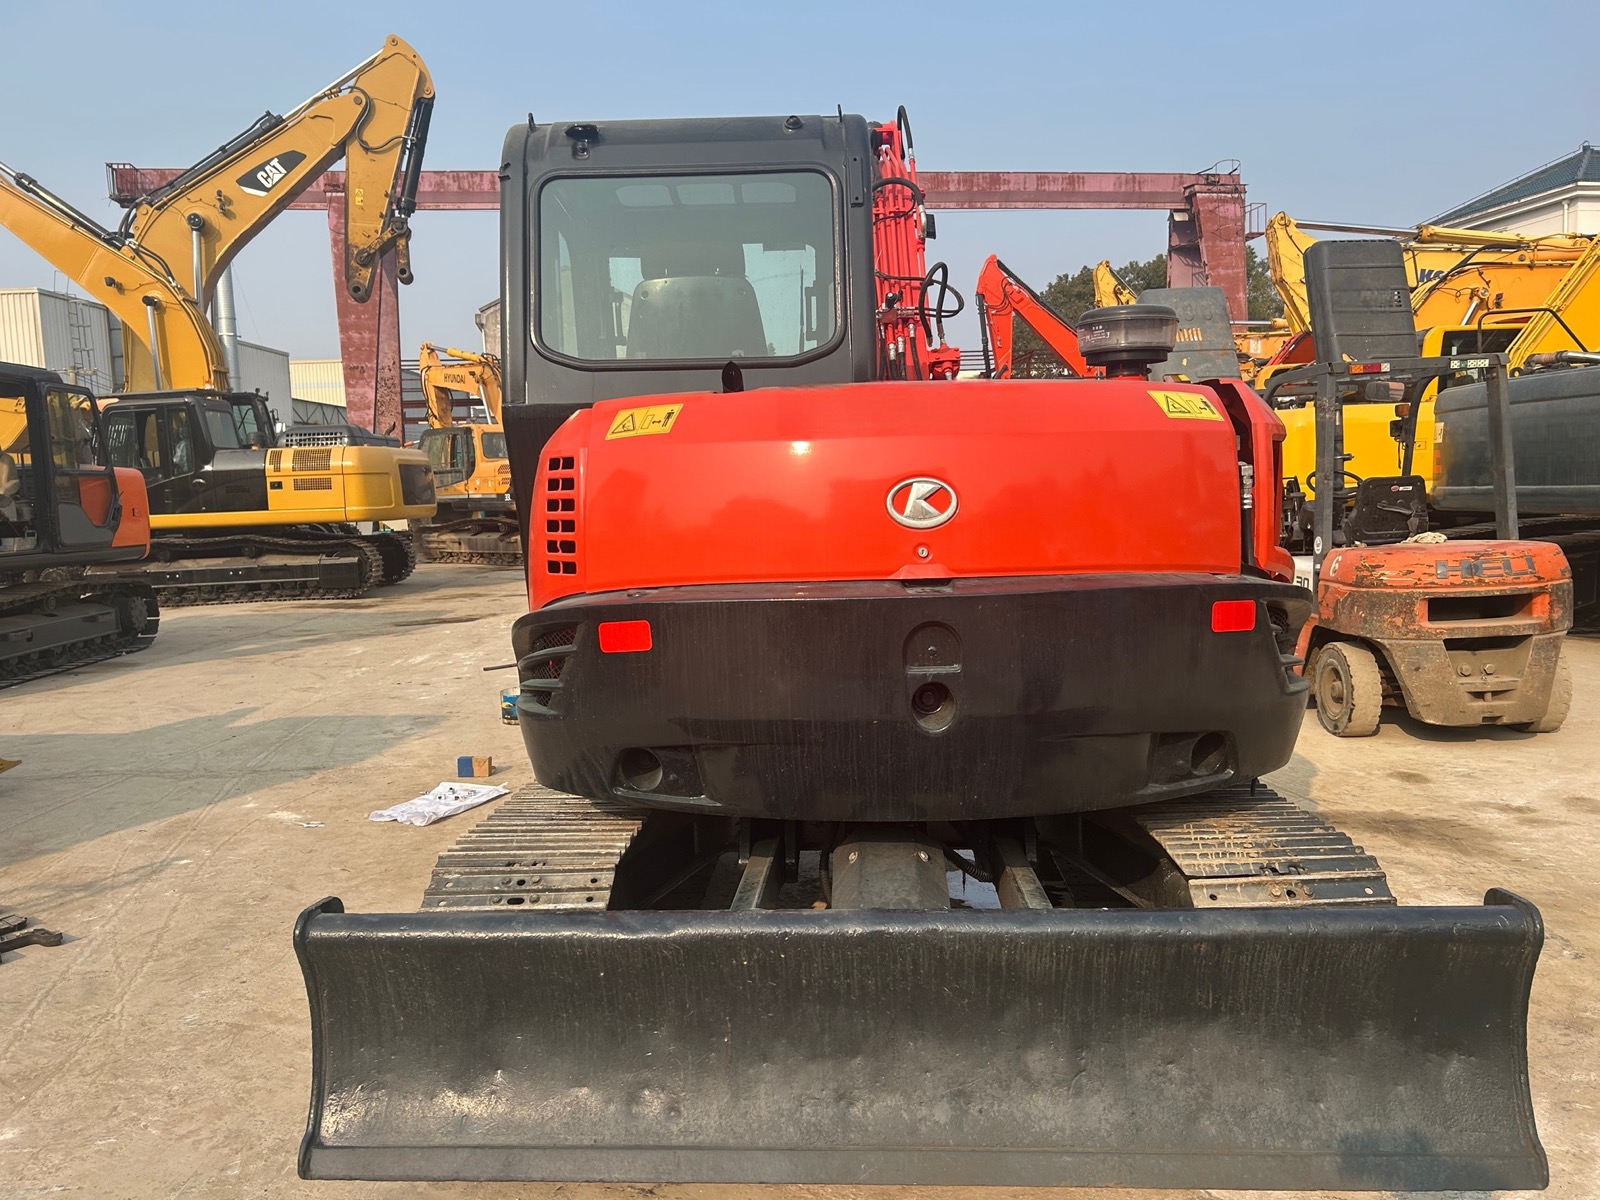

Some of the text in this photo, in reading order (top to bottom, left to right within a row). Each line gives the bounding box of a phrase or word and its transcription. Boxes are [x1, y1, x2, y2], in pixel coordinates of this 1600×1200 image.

[256, 157, 288, 189] CAT
[443, 373, 467, 385] HYUNDAI
[1329, 555, 1343, 577] 6
[1435, 556, 1537, 580] HELI
